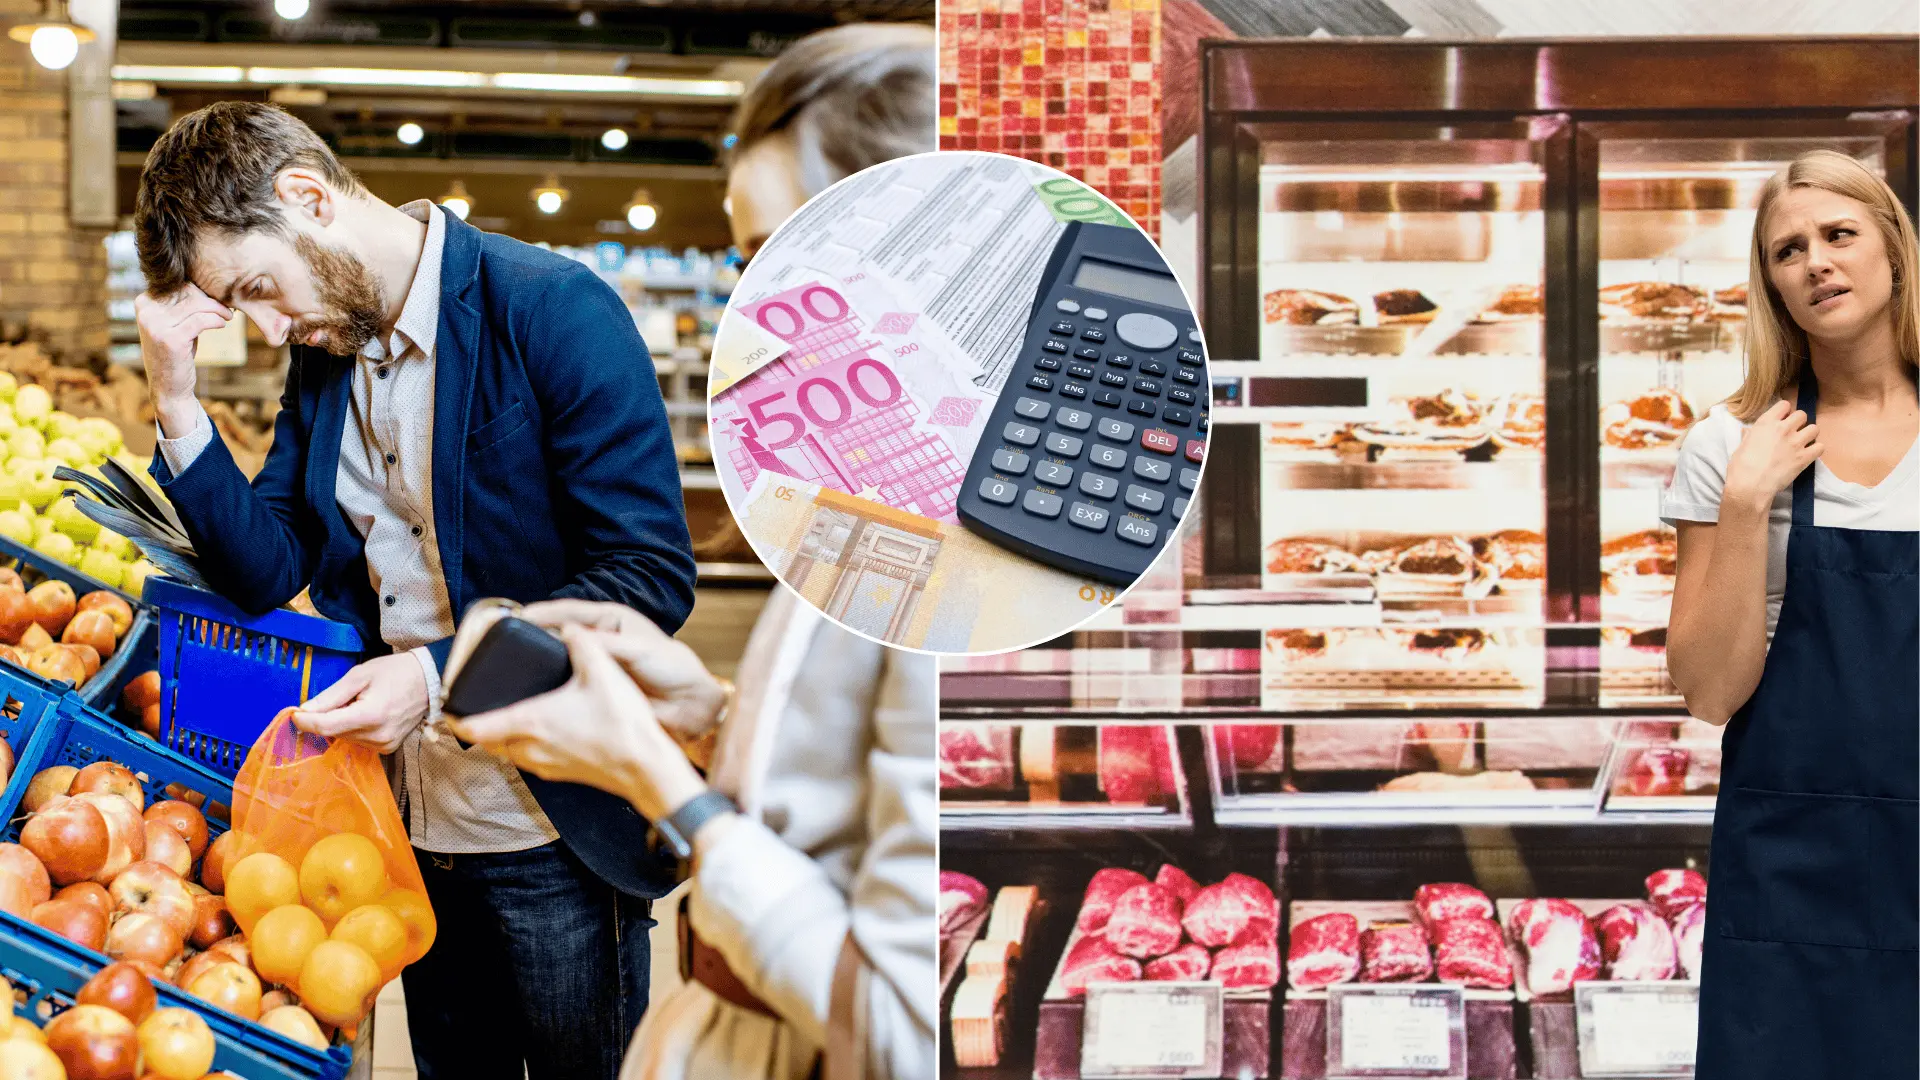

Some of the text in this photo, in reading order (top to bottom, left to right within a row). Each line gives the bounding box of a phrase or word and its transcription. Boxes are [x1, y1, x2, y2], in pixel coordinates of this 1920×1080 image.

[756, 286, 849, 344] 00
[1086, 330, 1103, 338] nCr
[894, 342, 919, 358] 500
[741, 347, 769, 367] 200
[1106, 372, 1124, 382] hyp
[1179, 369, 1194, 380] log
[1032, 376, 1049, 386] RCL
[1141, 380, 1156, 389] sin
[1064, 384, 1085, 394] ENG
[1173, 389, 1190, 399] cos
[748, 358, 902, 450] 500
[1028, 401, 1039, 413] 7
[934, 397, 975, 425] 500
[1068, 412, 1080, 423] 8
[1014, 428, 1026, 439] 4
[1110, 423, 1121, 434] 9
[1058, 438, 1070, 449] 5
[1148, 433, 1172, 447] DEL
[1102, 450, 1113, 461] 6
[1193, 446, 1205, 456] A
[1007, 455, 1014, 467] 1
[1047, 466, 1059, 479] 2
[992, 483, 1004, 496] 0
[1092, 478, 1104, 491] 3
[775, 486, 796, 502] 50
[1075, 507, 1103, 522] EXP
[1124, 522, 1150, 537] Ans
